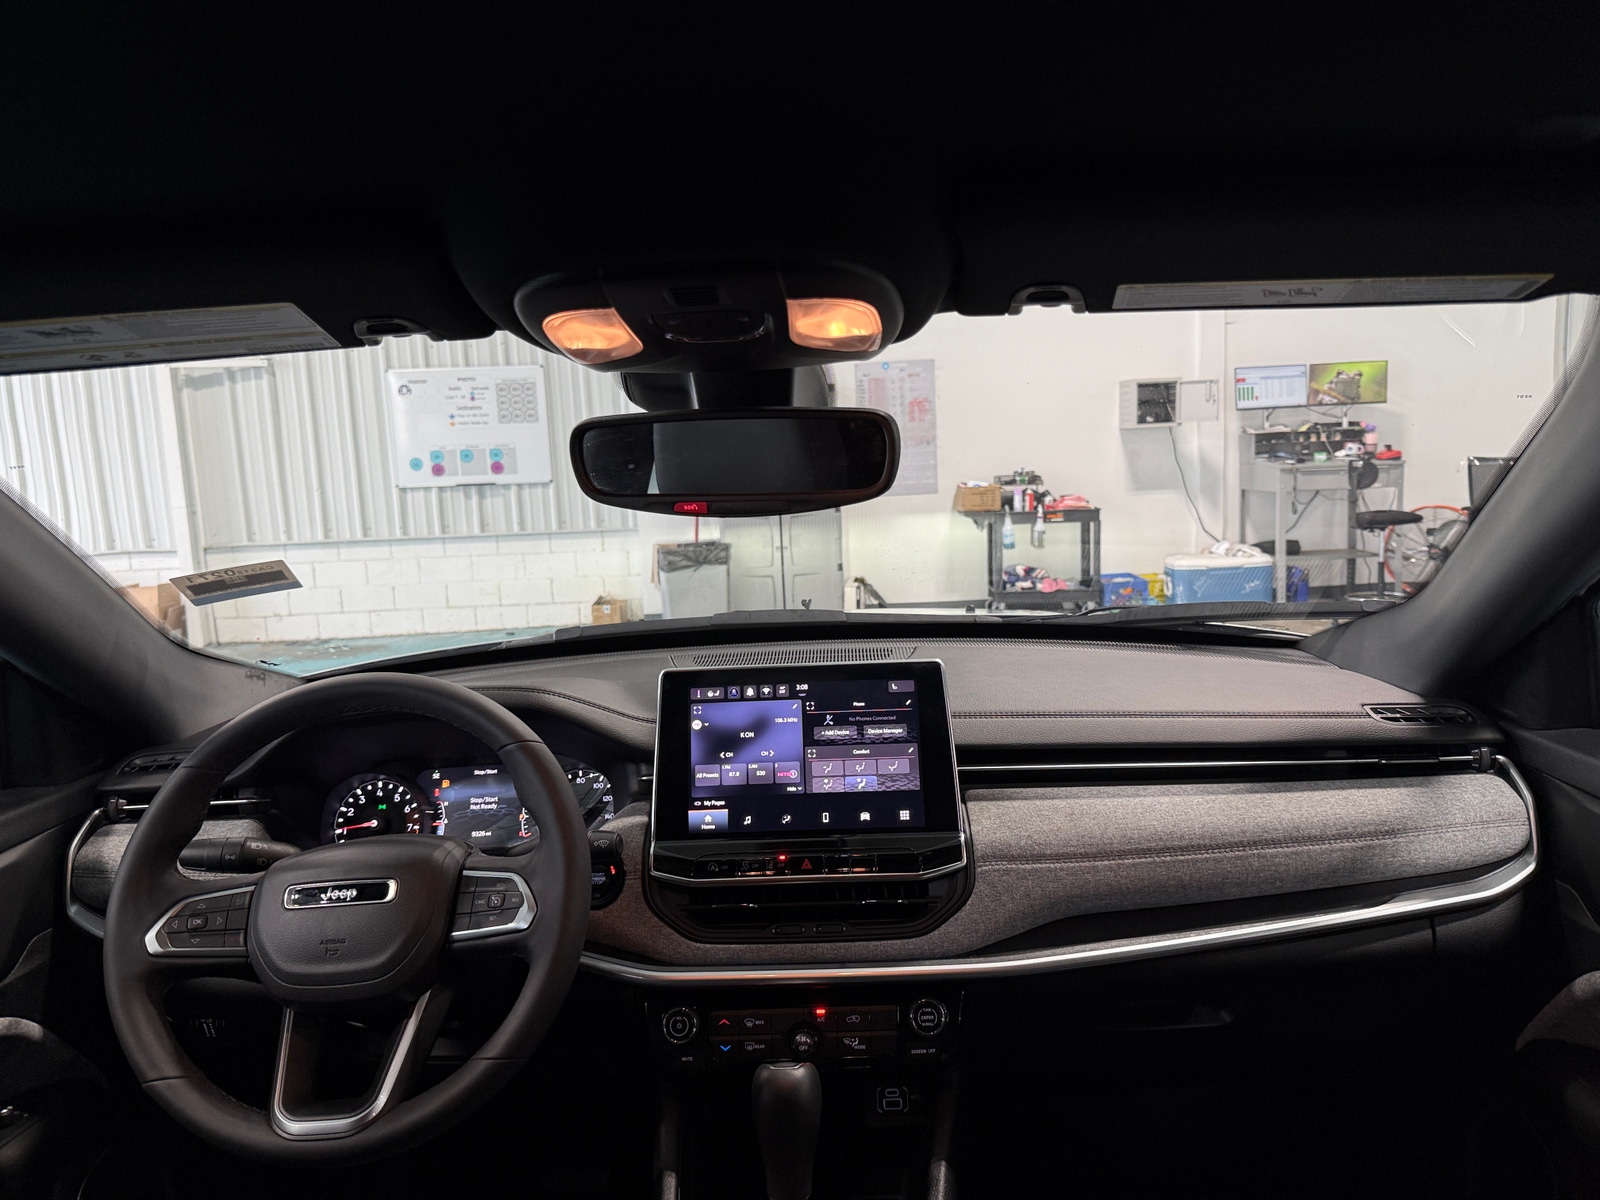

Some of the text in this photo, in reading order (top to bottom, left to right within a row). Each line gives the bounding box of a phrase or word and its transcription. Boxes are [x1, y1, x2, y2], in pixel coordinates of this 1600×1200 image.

[376, 789, 383, 797] 4
[358, 795, 366, 804] 3
[394, 794, 400, 802] 5
[470, 796, 498, 804] Stop/Start
[347, 808, 354, 816] 2
[404, 805, 411, 813] 6
[407, 824, 413, 832] 7
[320, 887, 358, 901] Jeep
[320, 938, 347, 946] AIRBAG
